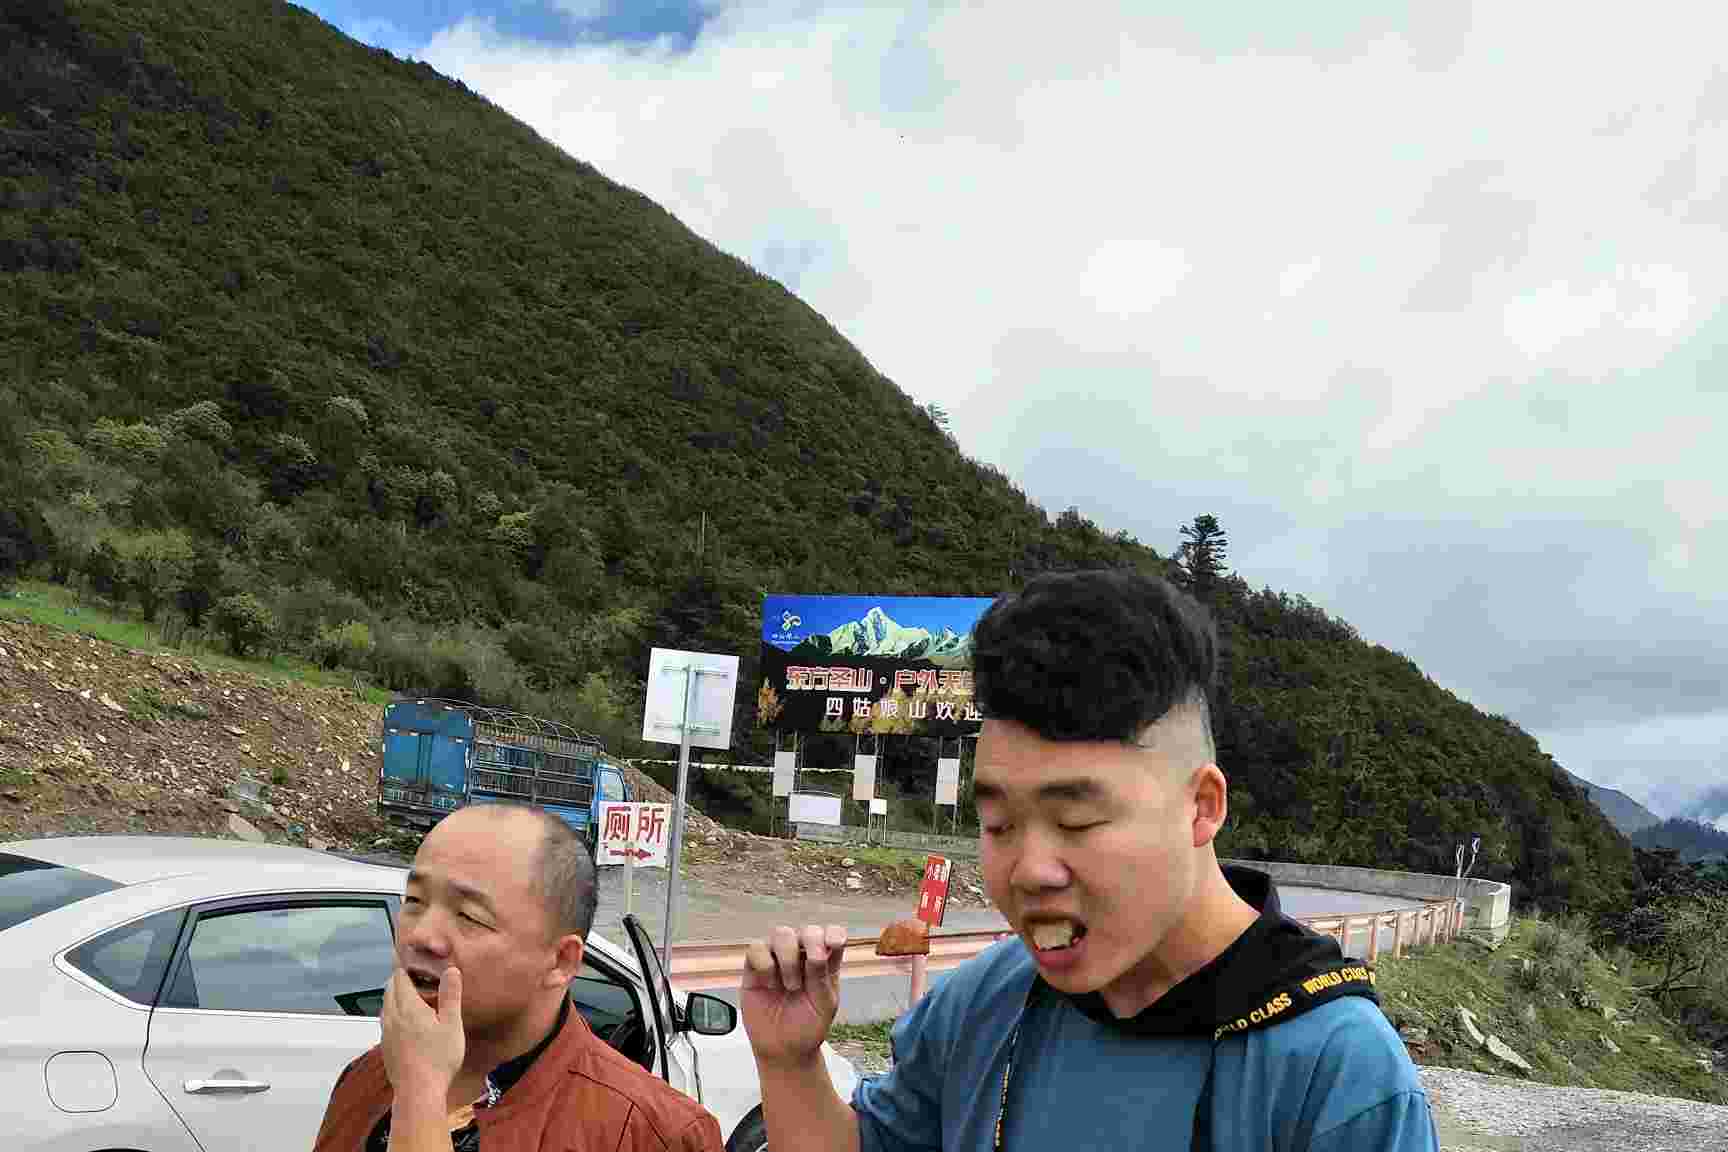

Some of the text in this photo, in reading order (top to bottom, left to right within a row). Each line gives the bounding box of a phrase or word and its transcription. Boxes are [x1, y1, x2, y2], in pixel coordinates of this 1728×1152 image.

[603, 805, 665, 843] 厕所
[1249, 992, 1293, 1024] CLASS
[1302, 971, 1343, 995] WORLD
